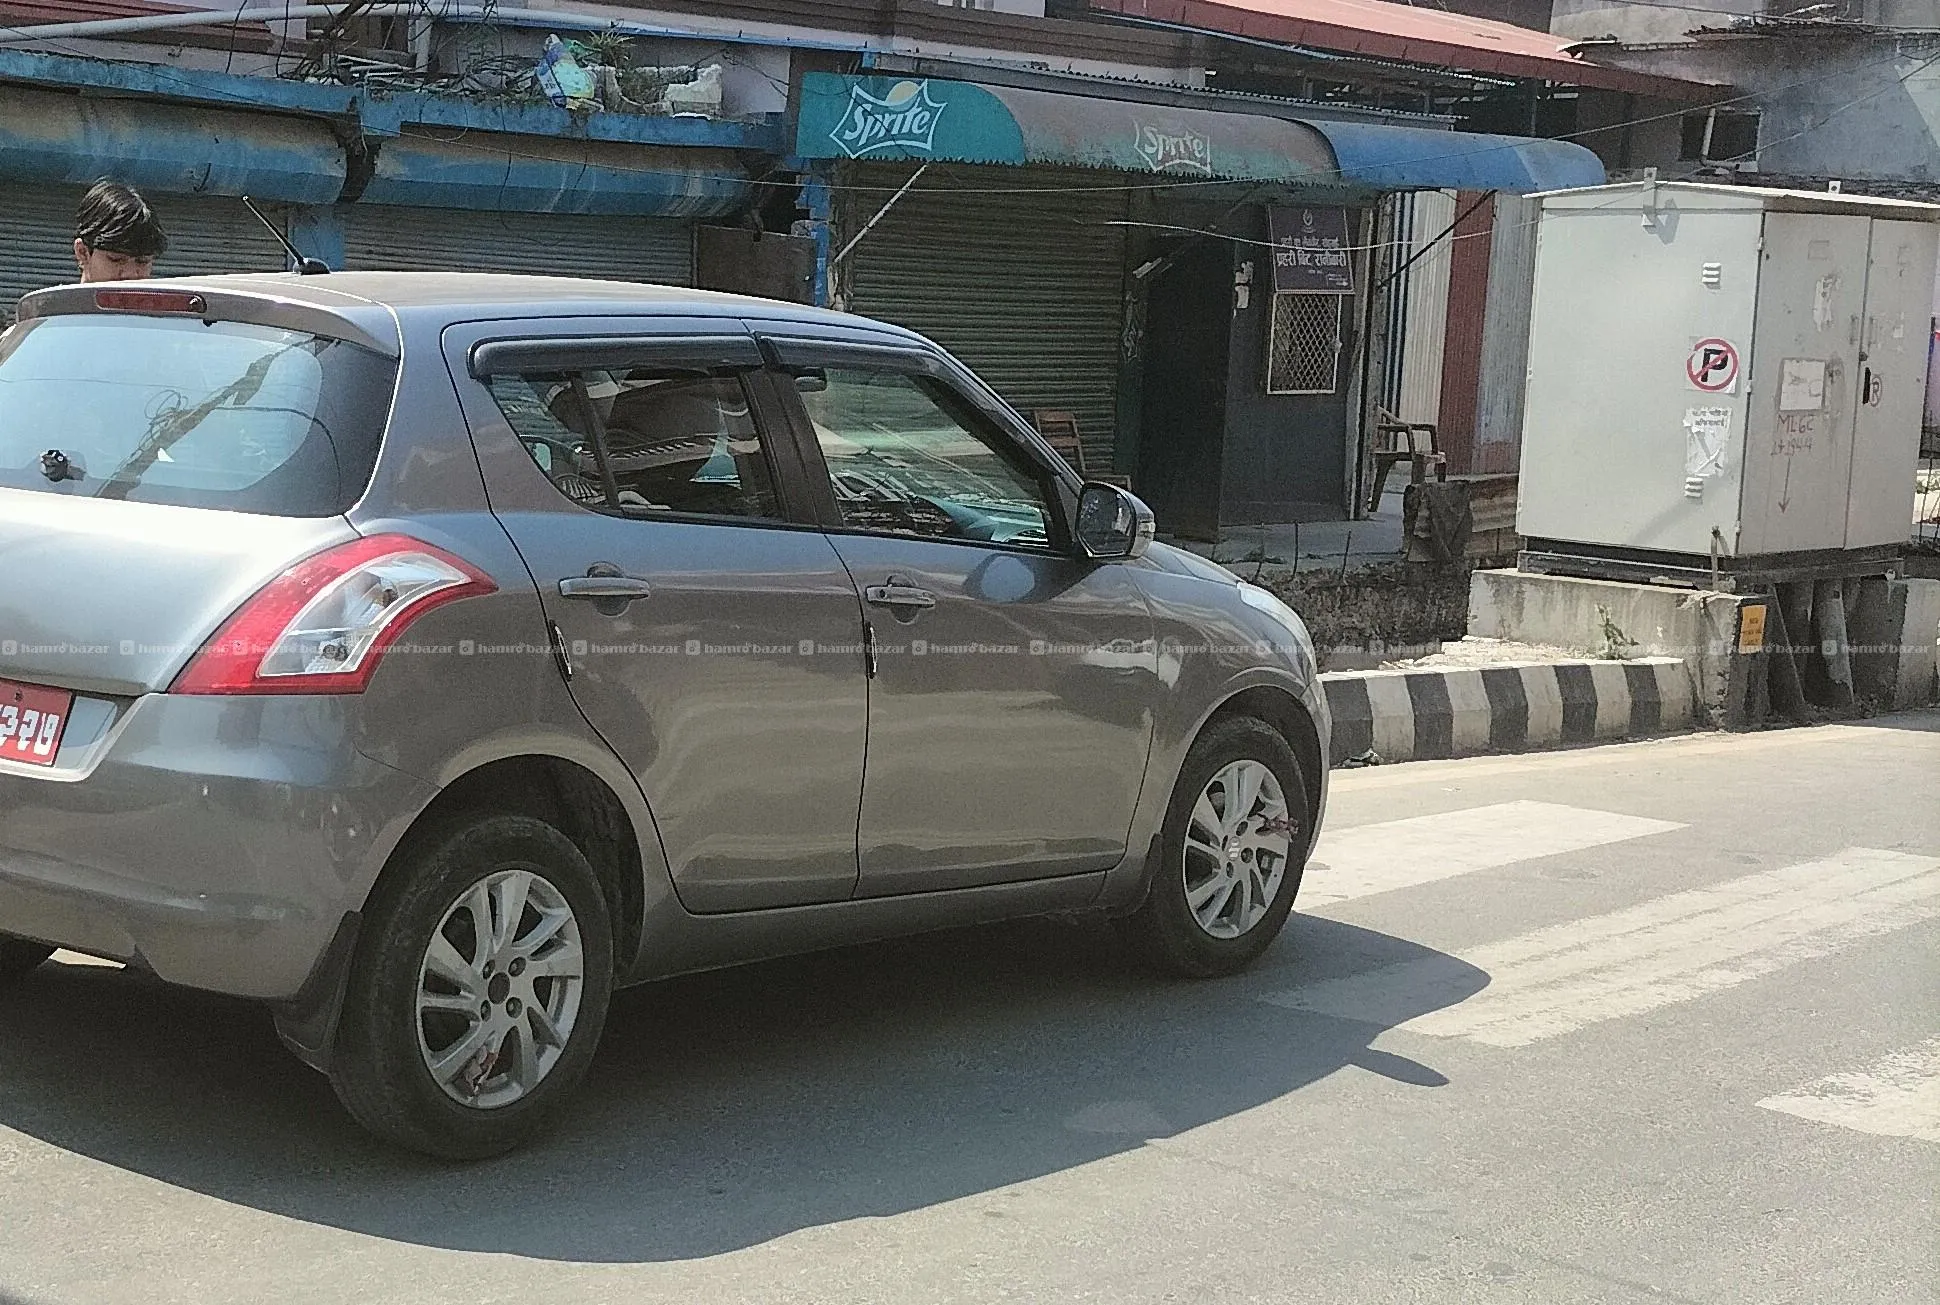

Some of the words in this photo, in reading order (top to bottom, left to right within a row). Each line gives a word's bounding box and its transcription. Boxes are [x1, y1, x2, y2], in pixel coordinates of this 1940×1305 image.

[842, 98, 931, 146] Sprite
[1143, 126, 1205, 161] Sprite
[1701, 348, 1729, 382] P
